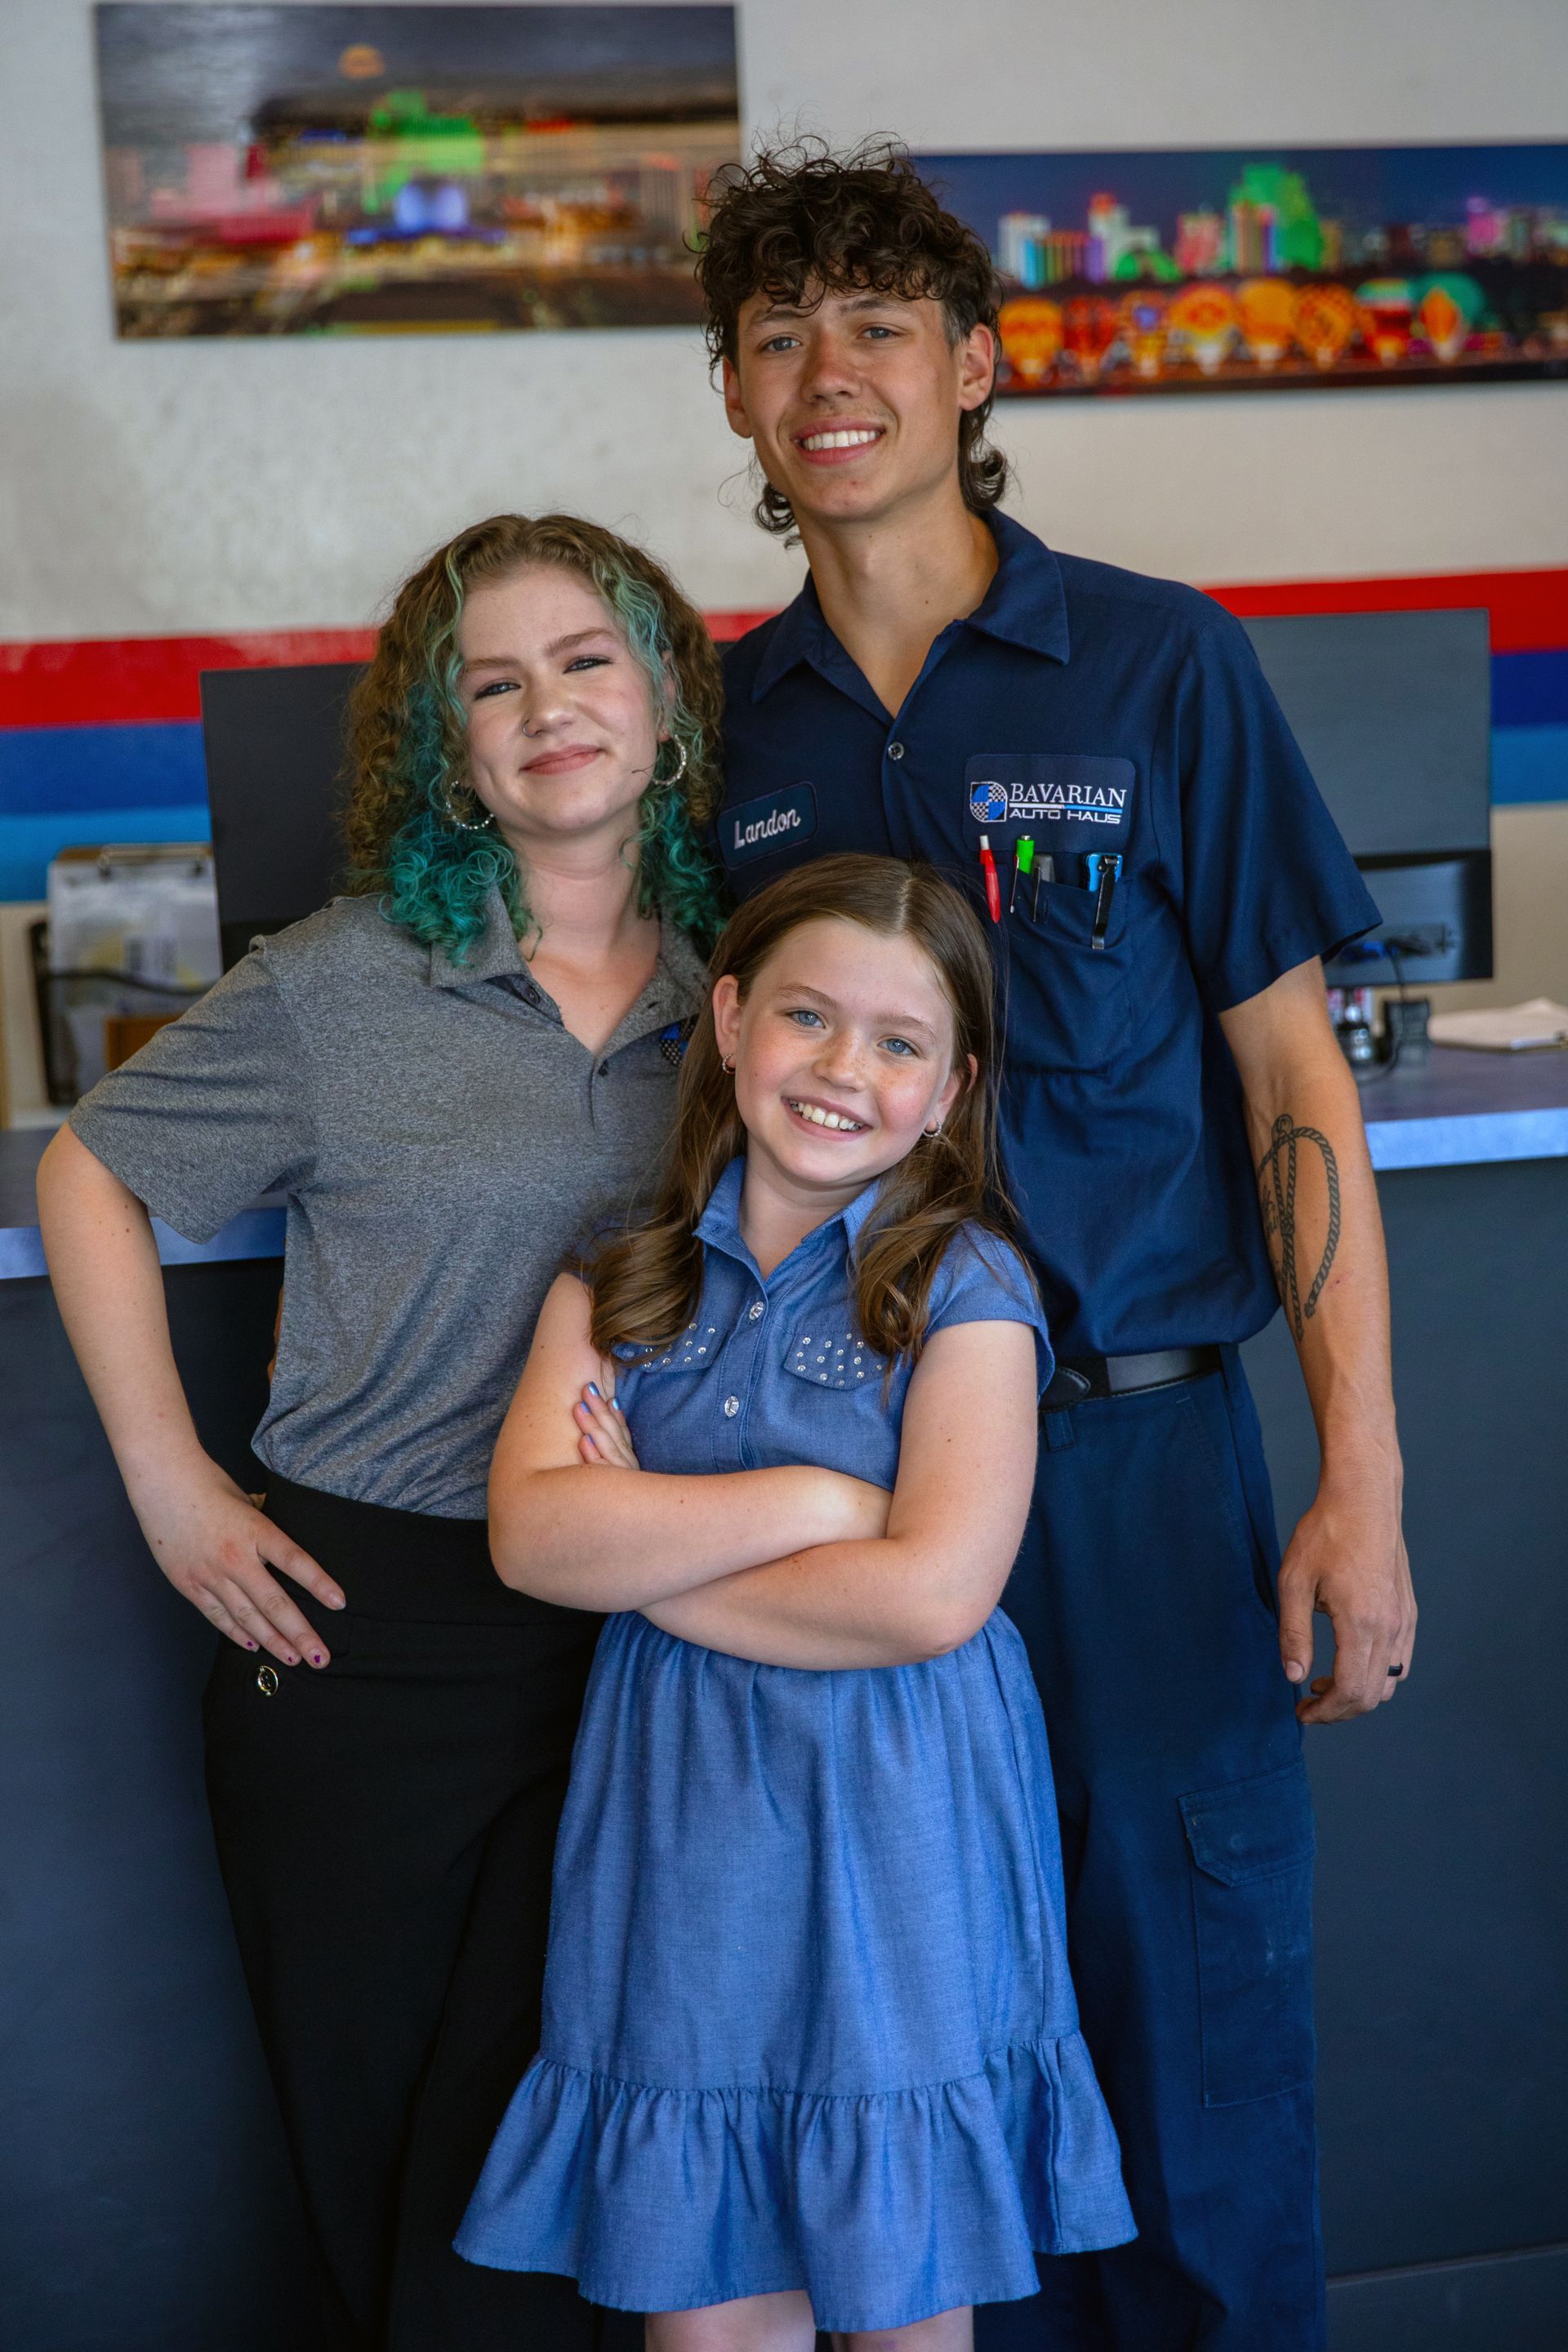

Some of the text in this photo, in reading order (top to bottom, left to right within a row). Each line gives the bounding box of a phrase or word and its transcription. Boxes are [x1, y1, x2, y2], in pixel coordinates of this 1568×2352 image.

[1009, 782, 1127, 808] BAVARIAN
[733, 808, 801, 849] Landon
[1009, 808, 1121, 825] AUTO HAUS
